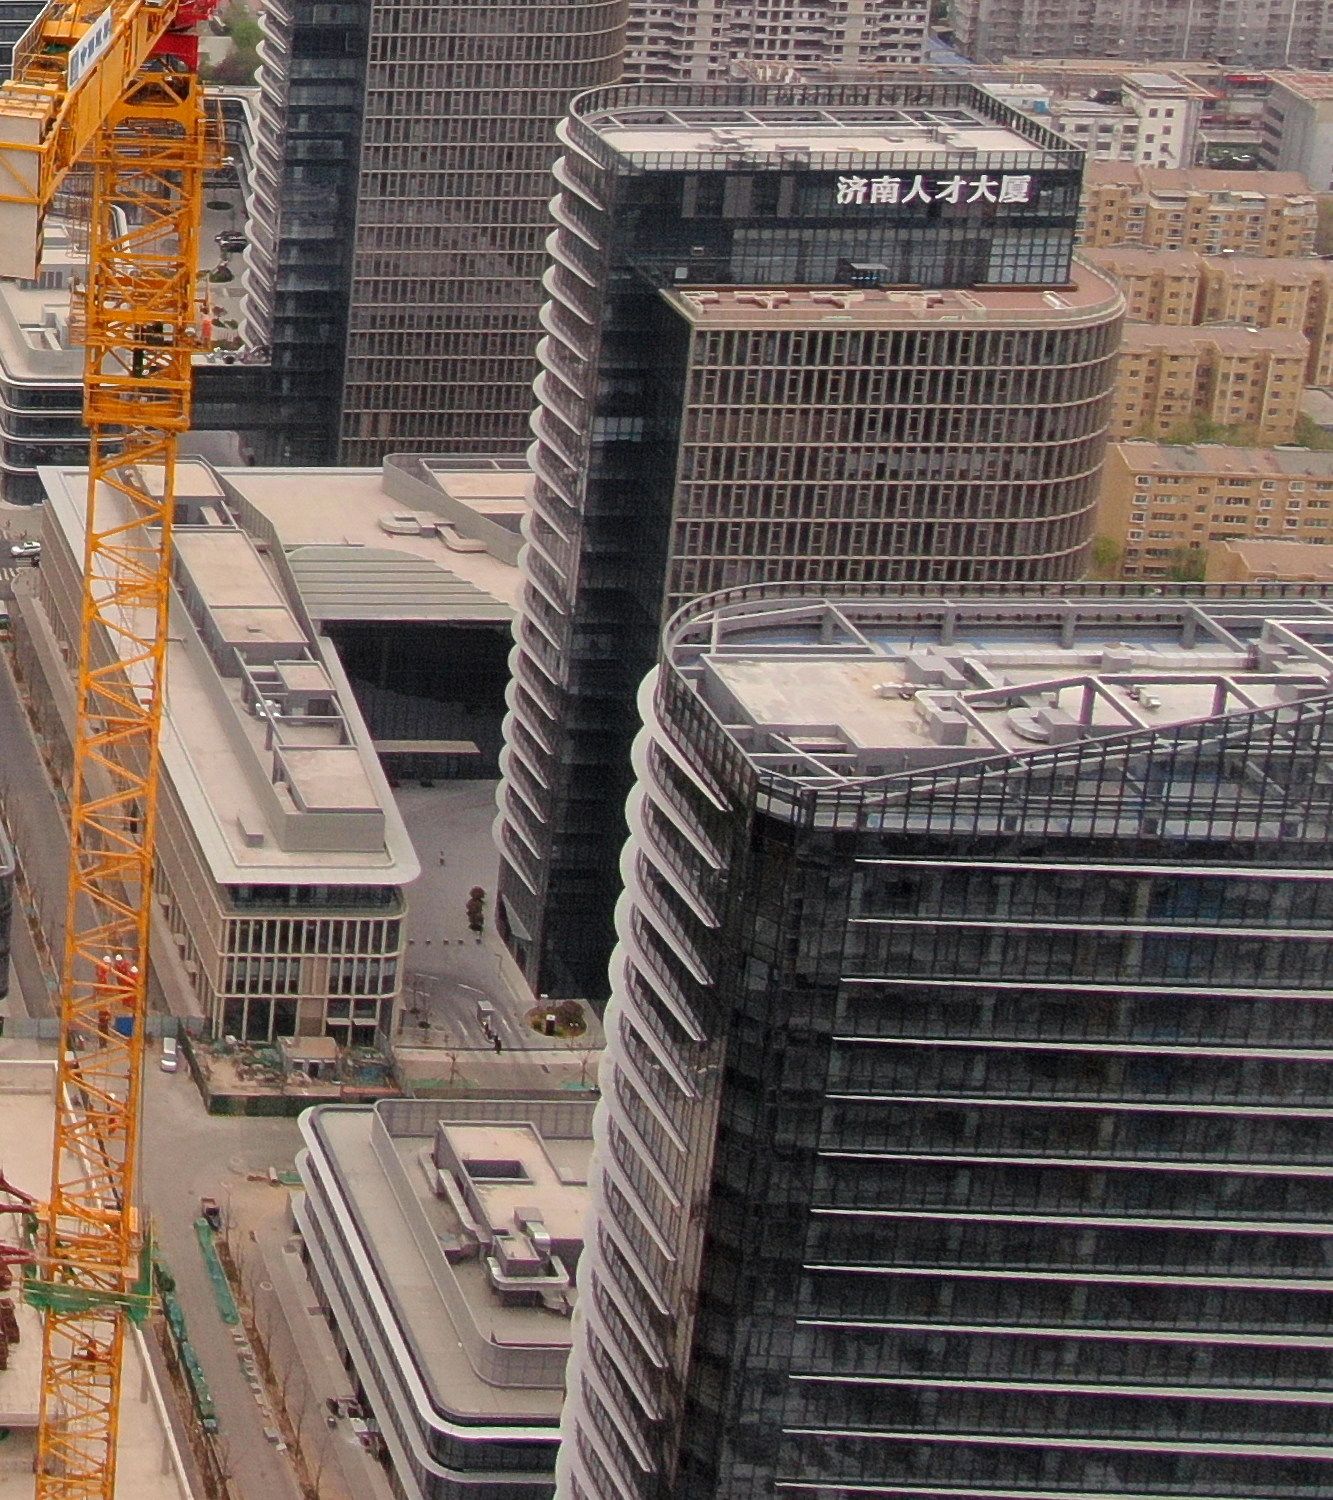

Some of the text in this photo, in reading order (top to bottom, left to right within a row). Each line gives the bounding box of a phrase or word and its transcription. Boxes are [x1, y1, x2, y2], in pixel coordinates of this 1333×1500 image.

[836, 174, 1032, 205] 济南人才大厦
